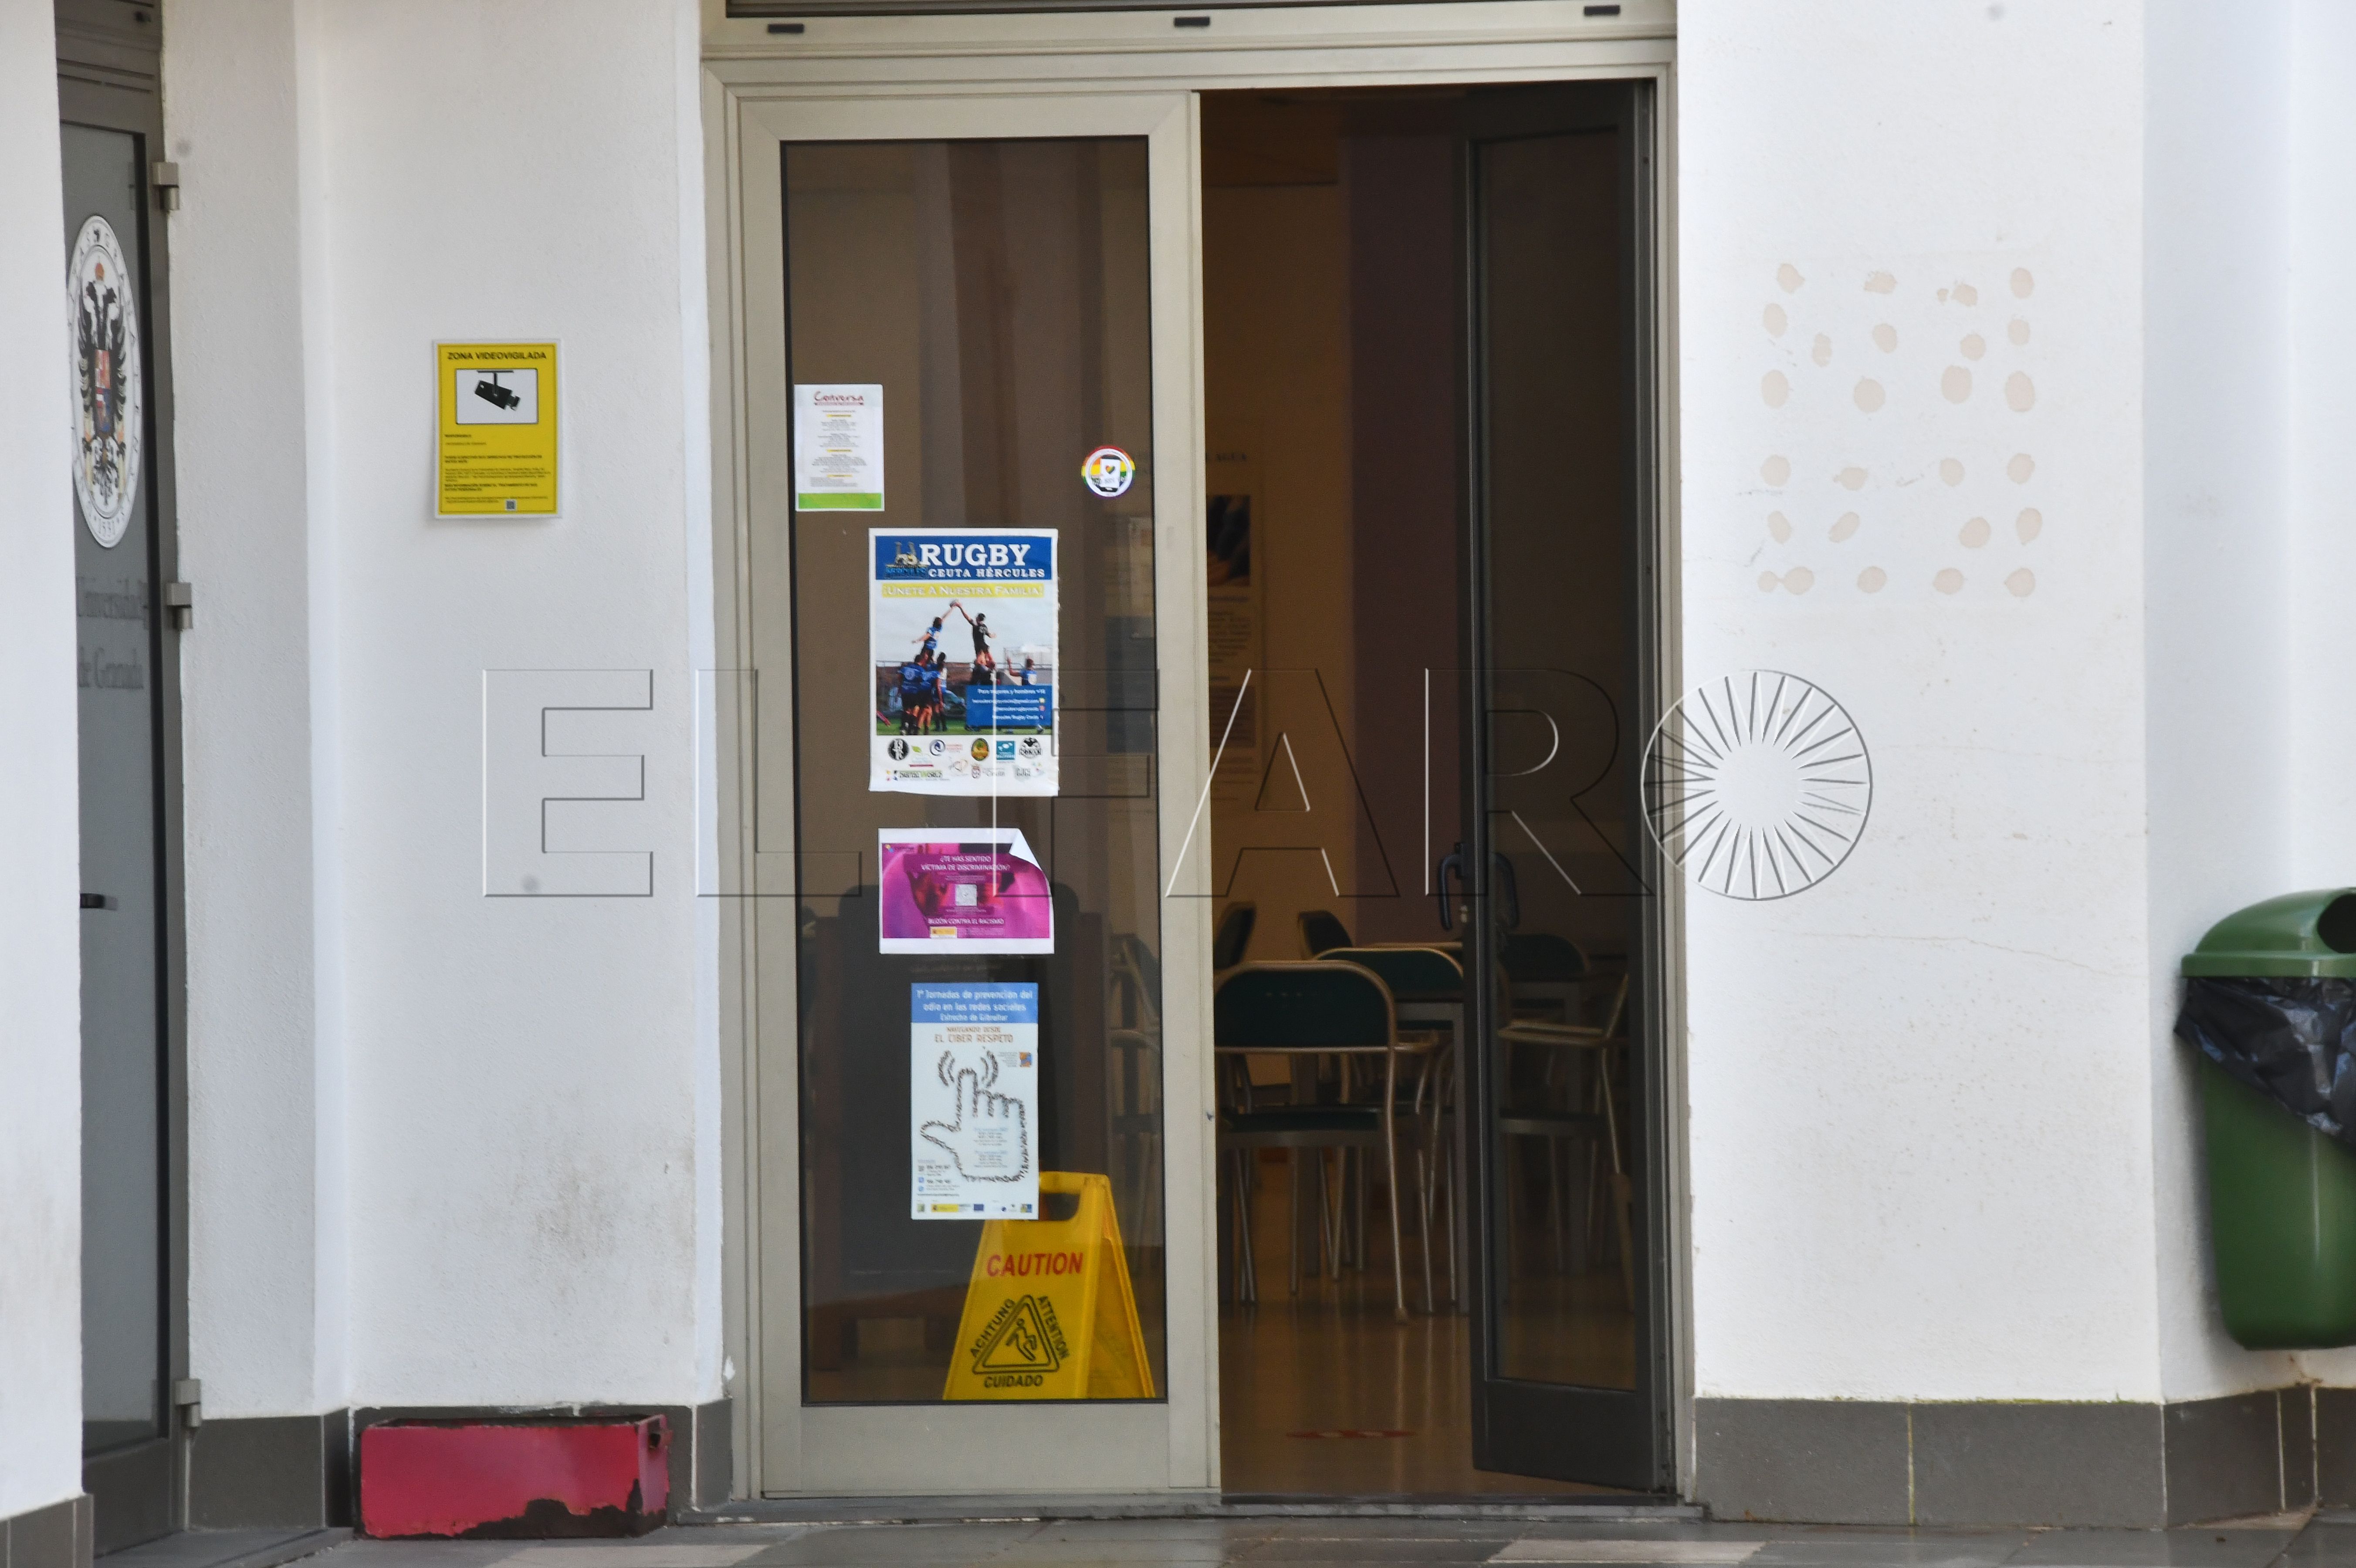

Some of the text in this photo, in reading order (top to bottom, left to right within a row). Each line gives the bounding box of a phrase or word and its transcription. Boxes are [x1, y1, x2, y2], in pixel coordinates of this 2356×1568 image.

[447, 351, 547, 360] ZONA VIDEOVIGILADA
[919, 544, 1031, 567] RUGBY
[928, 568, 972, 578] CEUTA
[929, 585, 937, 595] A
[962, 990, 972, 999] de
[1020, 990, 1032, 999] del
[923, 1002, 941, 1011] odio
[955, 1002, 967, 1011] las
[969, 1002, 992, 1011] redes
[993, 1002, 1027, 1011] sociales
[969, 1013, 978, 1021] de
[979, 1013, 1008, 1021] Gibraltar
[934, 1034, 944, 1043] EL
[976, 1034, 1014, 1043] RESPETO
[985, 1252, 1083, 1277] CAUTION
[1037, 1295, 1071, 1361] ATTENTION
[983, 1375, 1043, 1389] CUIDADO
